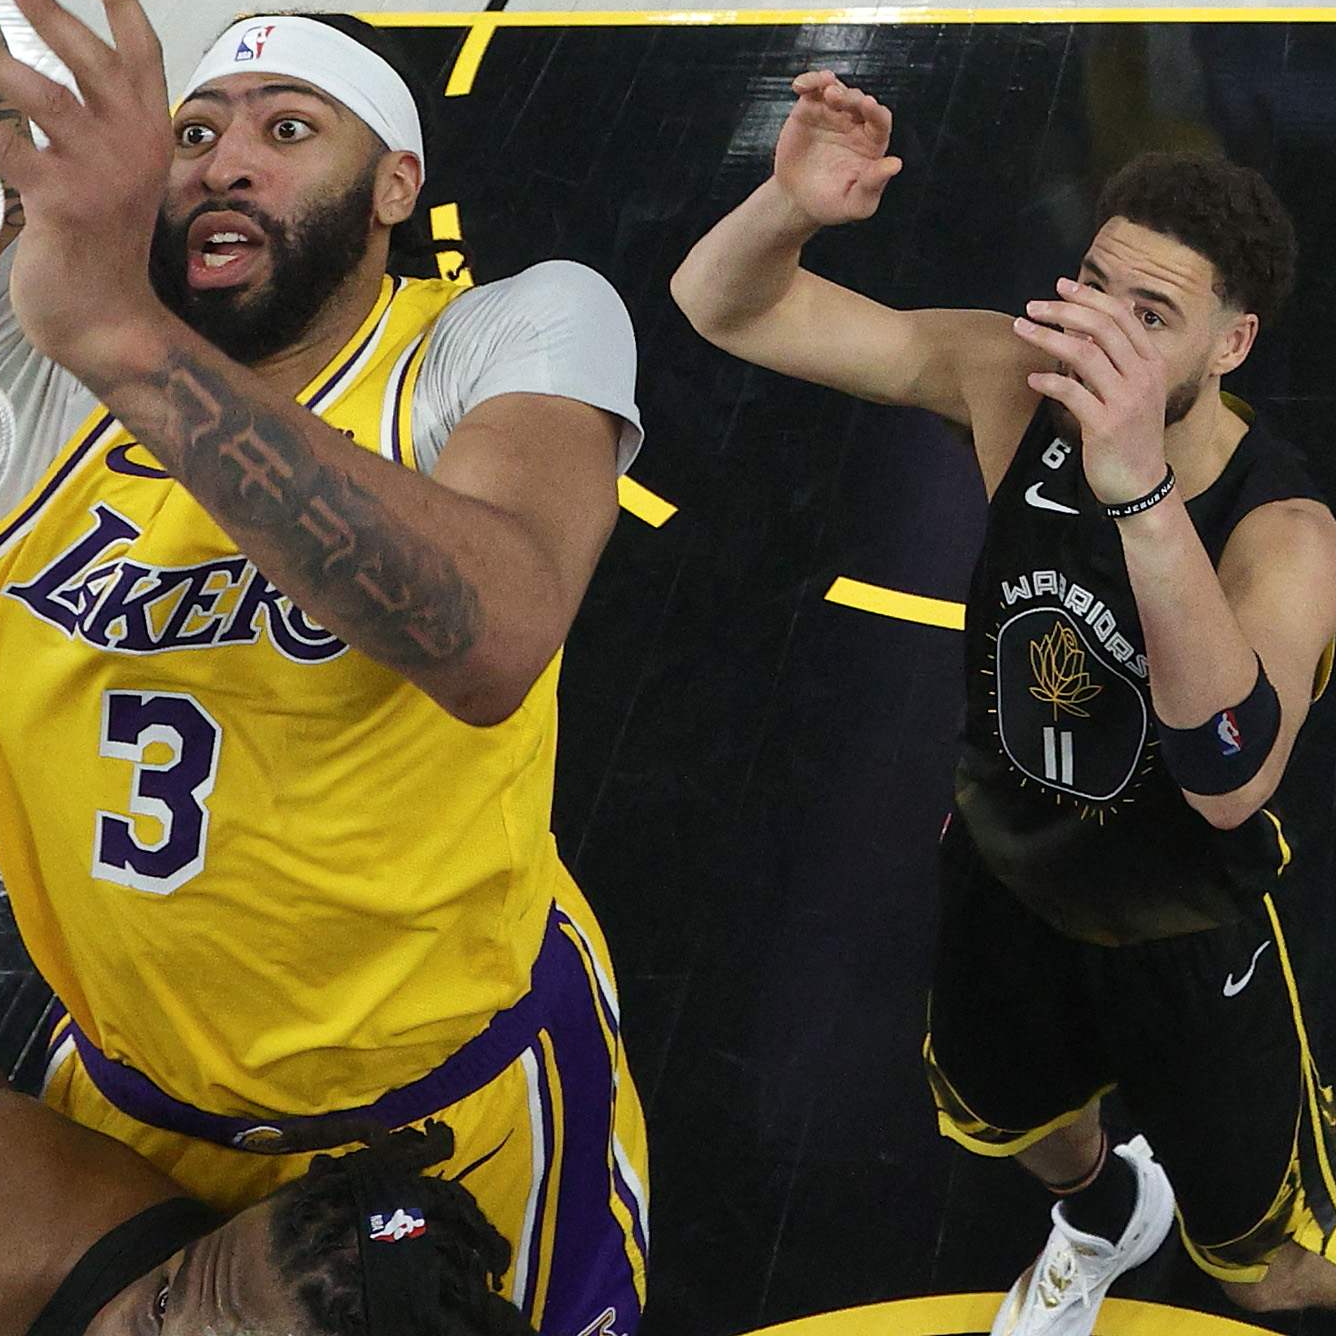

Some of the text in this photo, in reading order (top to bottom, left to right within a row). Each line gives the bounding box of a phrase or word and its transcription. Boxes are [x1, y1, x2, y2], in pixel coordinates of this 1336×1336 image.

[1042, 437, 1072, 470] 6
[1124, 493, 1161, 514] JESUS
[0, 500, 351, 665] LAKER
[1042, 726, 1074, 786] 11
[92, 688, 224, 896] 3
